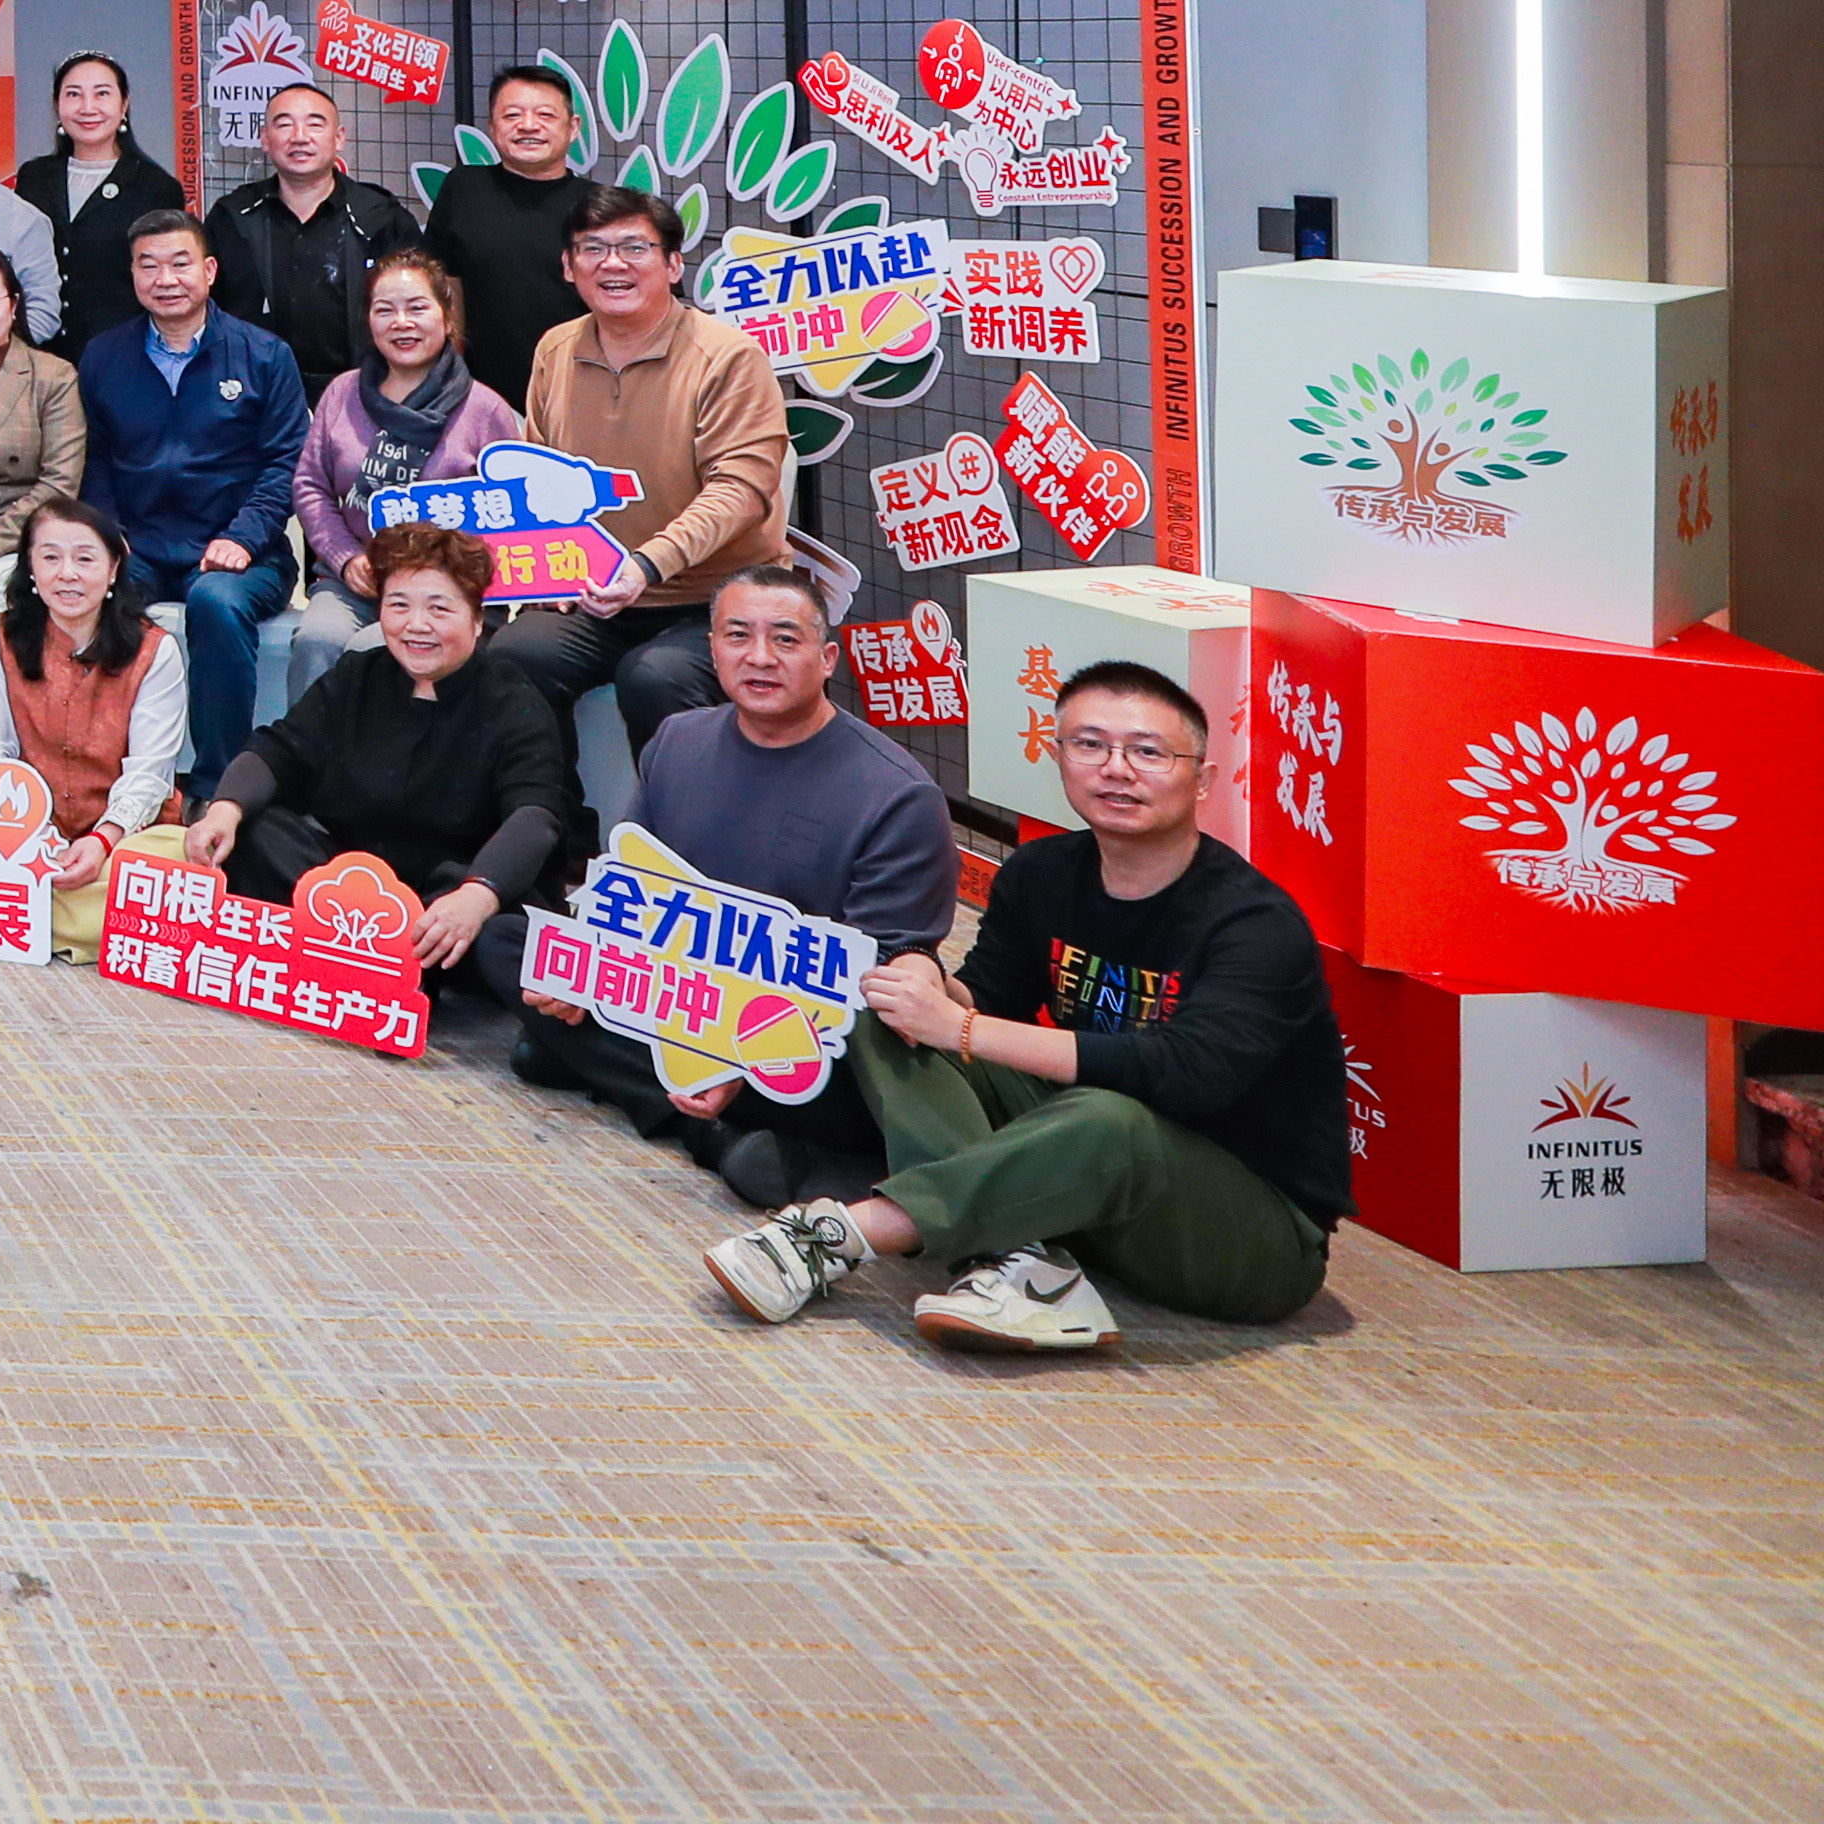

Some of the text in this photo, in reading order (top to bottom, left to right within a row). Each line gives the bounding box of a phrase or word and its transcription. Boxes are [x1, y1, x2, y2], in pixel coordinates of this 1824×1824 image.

[324, 39, 408, 92] 内力萌生
[351, 22, 441, 72] 文化引领
[987, 51, 1054, 95] User-centric
[179, 2, 196, 204] SUCCESSION AND GROWTH
[989, 74, 1044, 114] 以用户
[1159, 96, 1181, 145] AND
[841, 88, 934, 174] 思利及人
[973, 100, 1037, 151] 为中心
[999, 150, 1110, 189] 永远创业
[998, 192, 1113, 203] Constant Entrepreneurship
[1160, 156, 1186, 310] SUCCESSION
[720, 232, 936, 312] 全力以赴
[964, 249, 1044, 297] 实践
[741, 304, 845, 357] 前冲
[969, 304, 1089, 356] 新调养
[1164, 321, 1190, 441] INFINITUS
[1008, 380, 1089, 478] 赋能
[381, 488, 516, 530] 敢梦想
[878, 460, 952, 514] 定义
[1002, 435, 1101, 547] 新伙伴
[902, 504, 1012, 564] 新观念
[1167, 469, 1193, 573] GROWTH
[1335, 490, 1511, 539] 传承与发展
[850, 627, 919, 677] 传承
[867, 674, 965, 723] 与发展
[1267, 659, 1344, 766] 传承与
[1276, 749, 1334, 847] 发展
[115, 858, 294, 951] 向根生长
[1497, 857, 1676, 905] 传承与发展
[587, 871, 850, 1006] 全力以赴
[106, 932, 419, 1049] 积蓄信任生产力
[532, 924, 723, 1037] 向前冲
[1527, 1139, 1642, 1159] INFINITUS
[1540, 1166, 1626, 1199] 无限极
